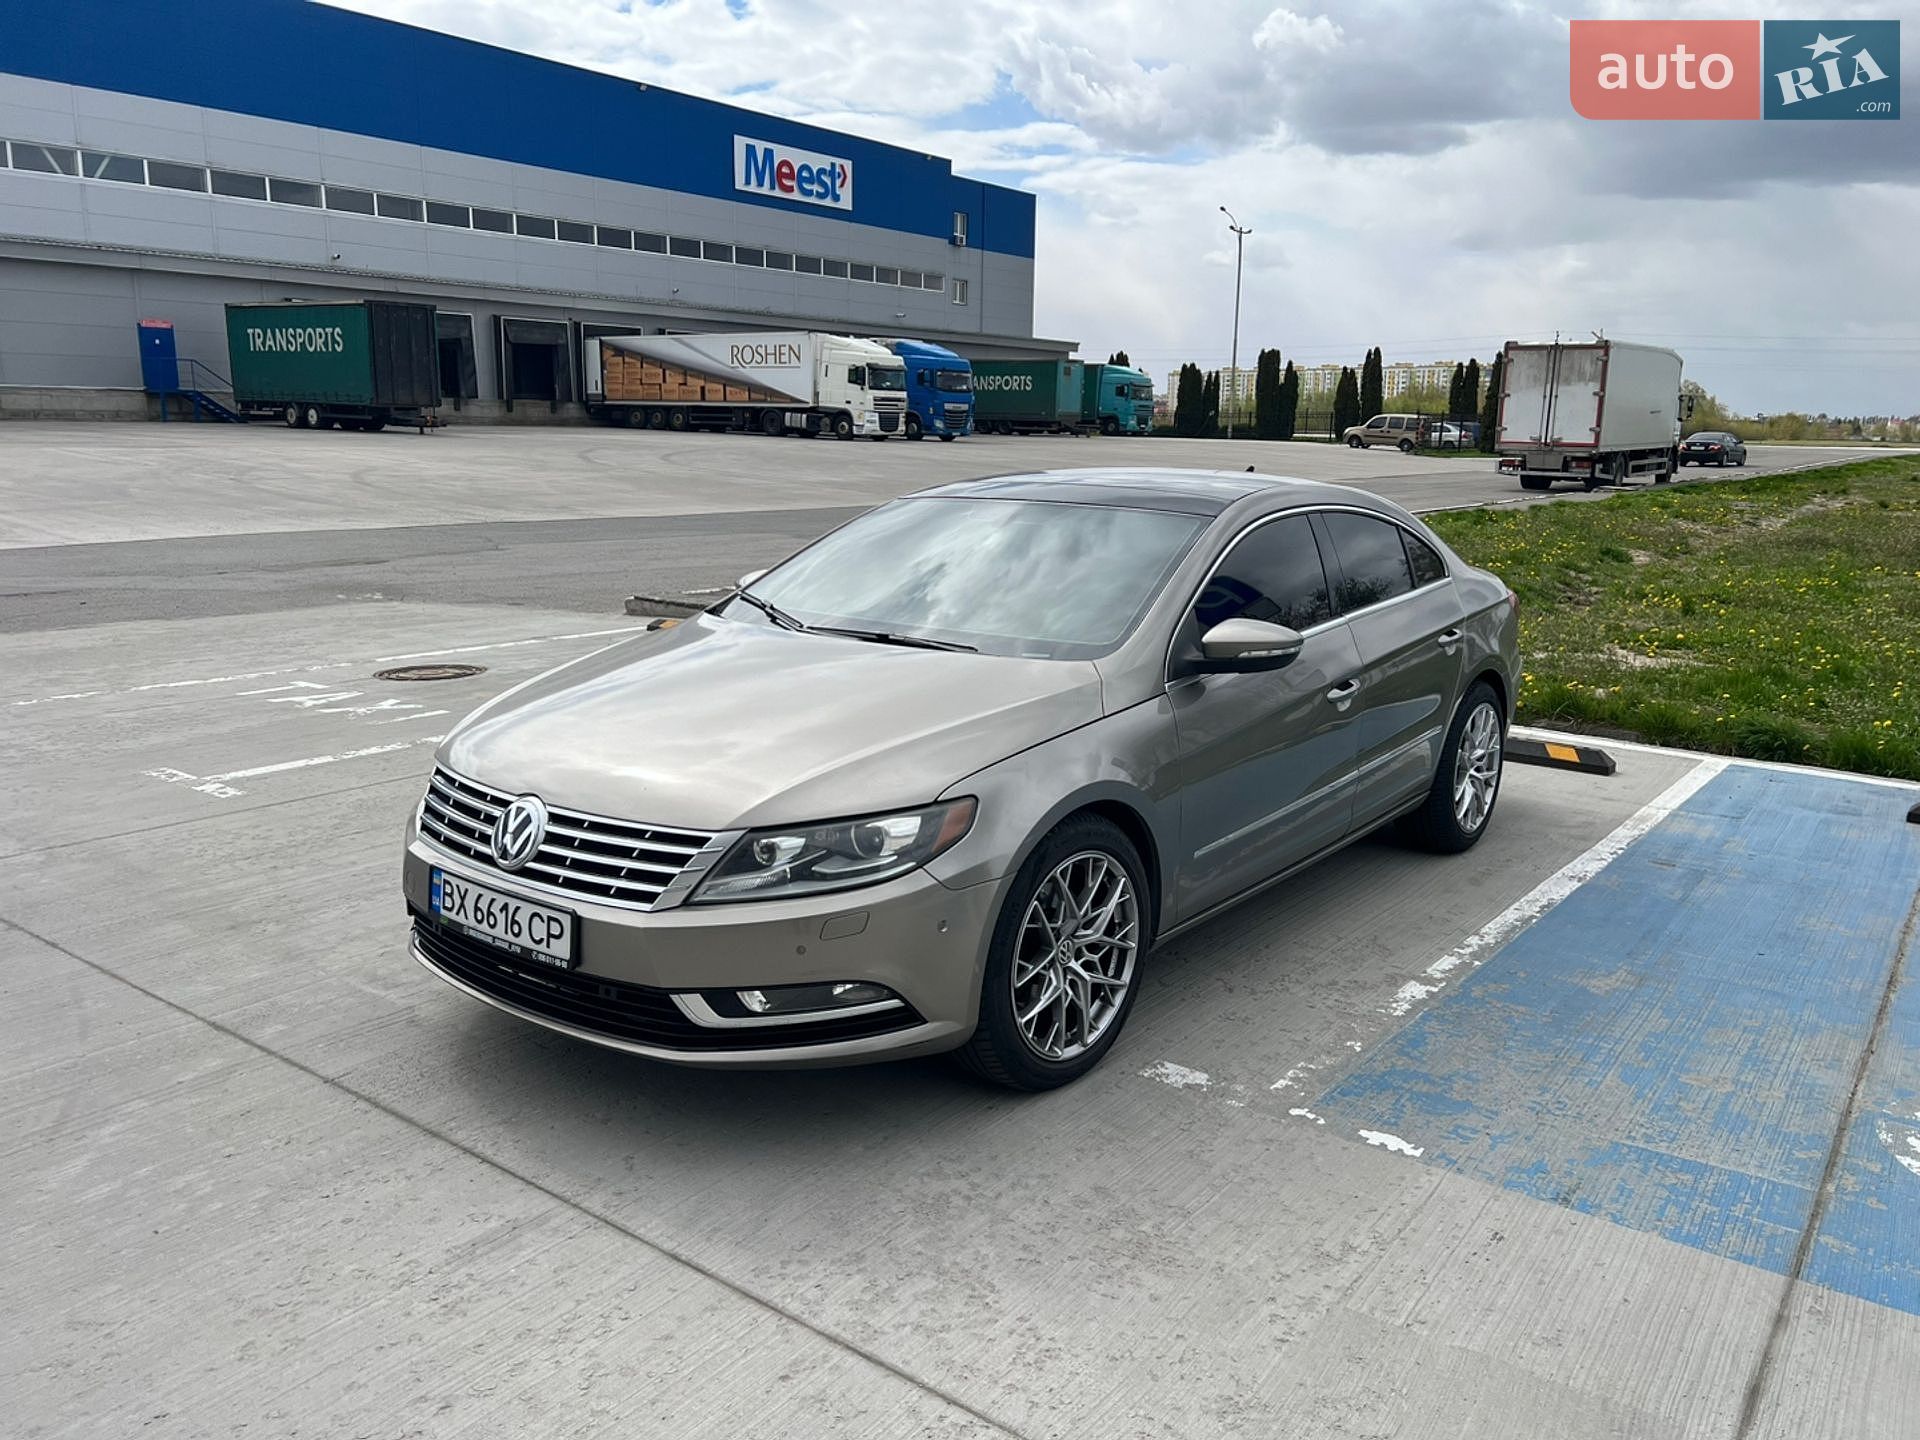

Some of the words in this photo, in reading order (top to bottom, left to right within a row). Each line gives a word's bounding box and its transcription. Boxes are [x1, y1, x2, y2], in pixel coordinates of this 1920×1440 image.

[743, 142, 841, 203] Meest
[246, 326, 344, 352] TRANSPORTS
[730, 344, 801, 368] ROSHEN
[973, 375, 1033, 391] ANSPORTS
[442, 878, 469, 920] BX
[473, 893, 523, 938] 6616
[528, 911, 565, 949] CP
